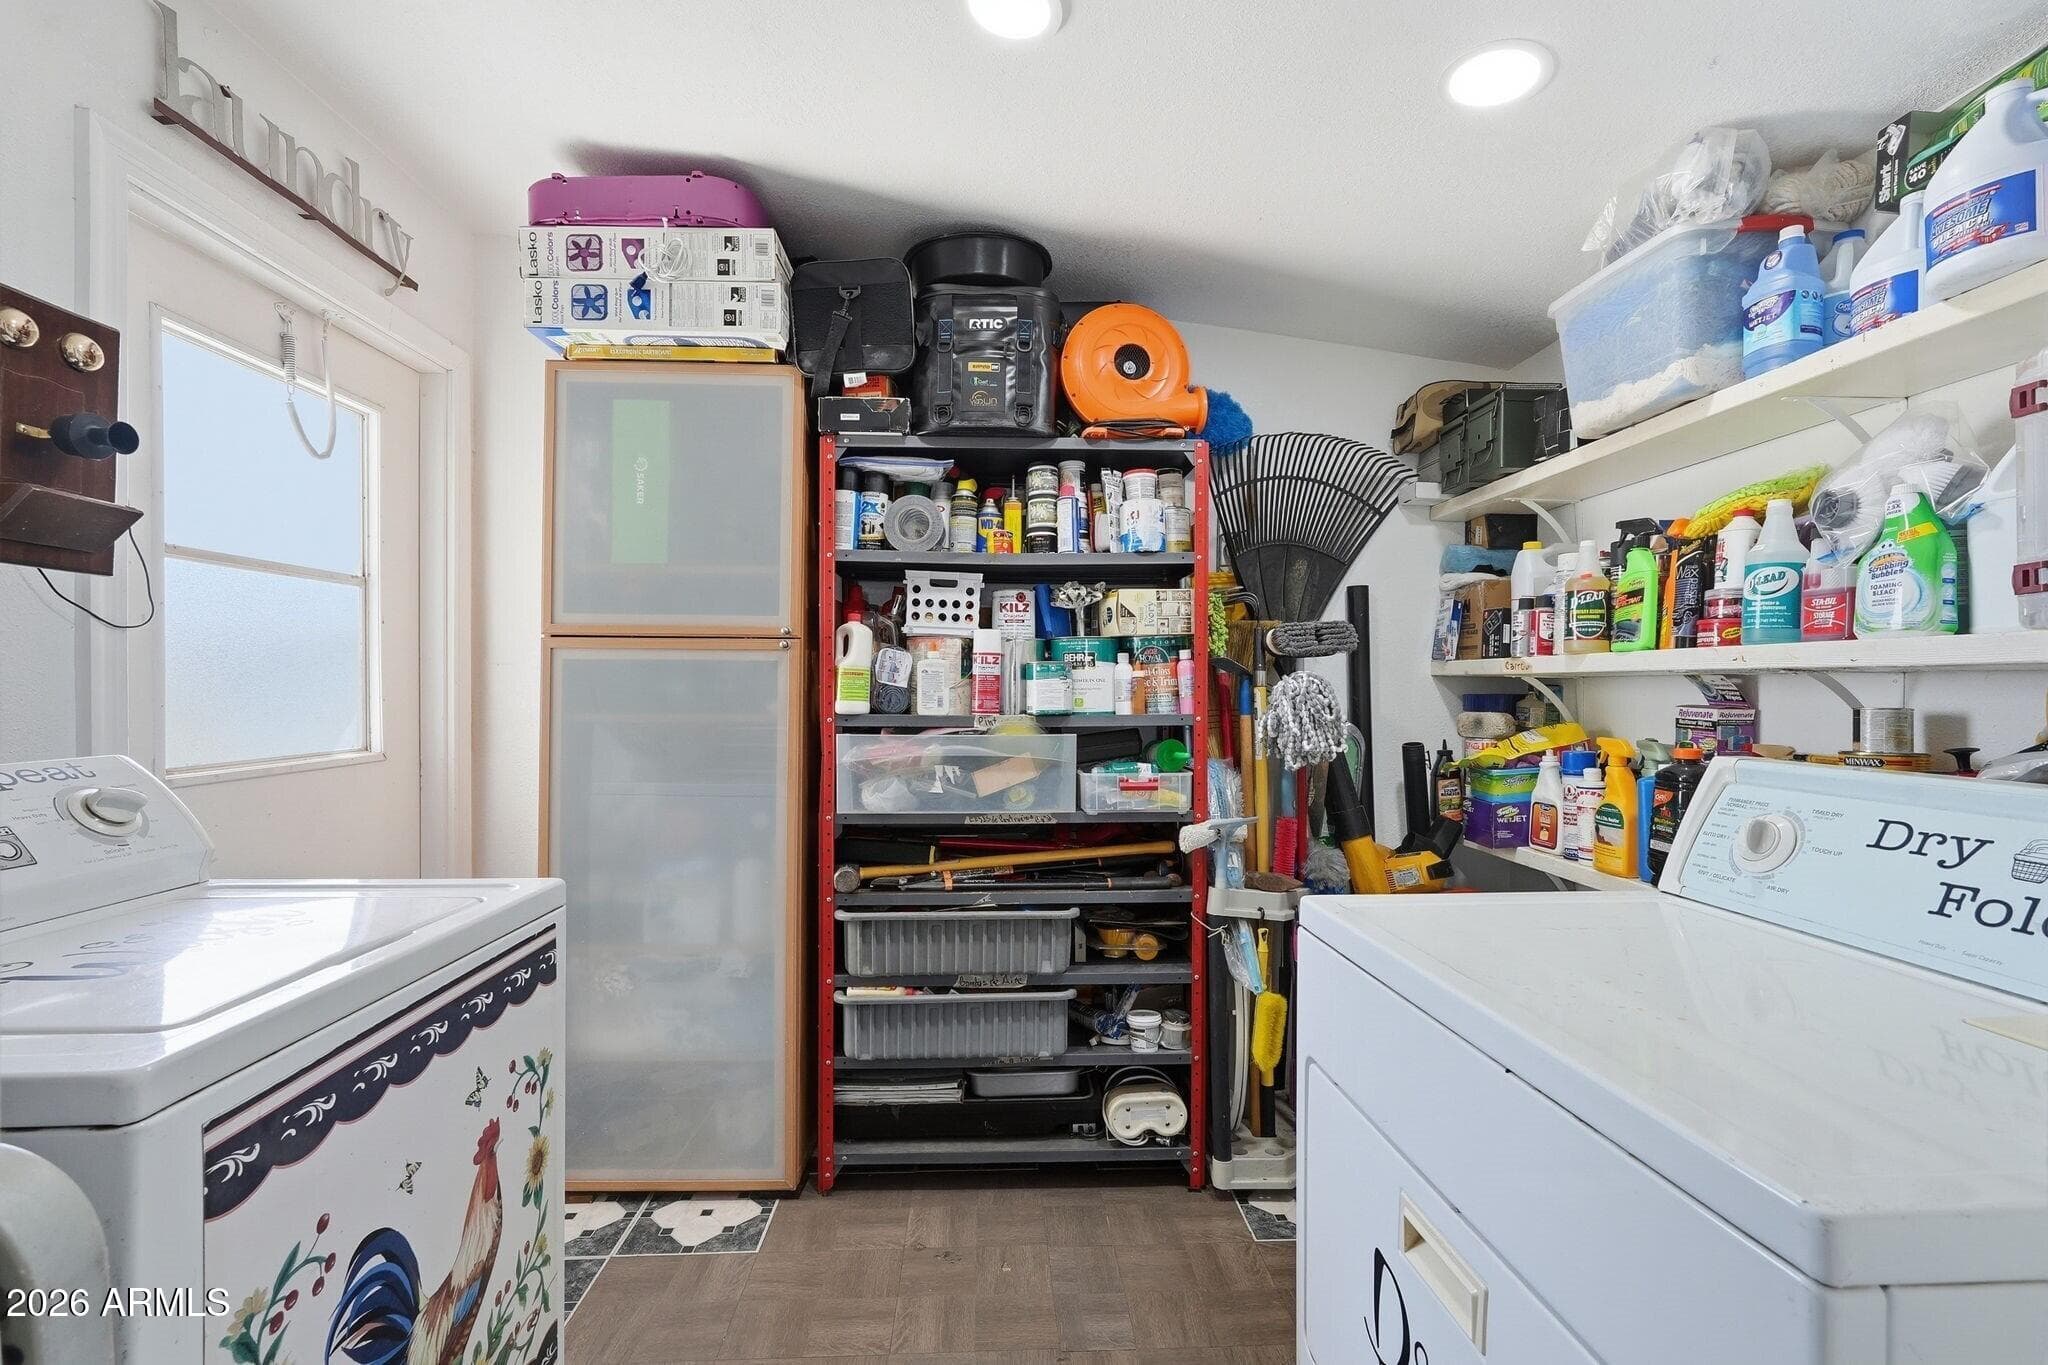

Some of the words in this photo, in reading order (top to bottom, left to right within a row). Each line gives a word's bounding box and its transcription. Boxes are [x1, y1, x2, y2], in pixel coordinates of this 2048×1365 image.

[1878, 160, 1892, 204] Shark
[546, 232, 554, 262] Colors
[527, 231, 539, 277] Lasko
[551, 281, 560, 309] Colors
[532, 280, 543, 324] Lasko
[968, 318, 1004, 330] RTIC
[636, 473, 645, 504] SAKER
[862, 501, 879, 513] 2X
[980, 518, 1004, 530] WD-4
[1677, 564, 1699, 580] Wax
[1868, 560, 1909, 575] Scrubbing
[1871, 568, 1904, 580] Bubbles
[1870, 581, 1902, 590] FOAMING
[1000, 602, 1030, 613] KILZ
[1811, 597, 1837, 606] STA-BIL
[973, 656, 1000, 665] KILZ
[1063, 653, 1085, 662] BEHR
[1678, 708, 1714, 719] Rejuvenate
[1719, 710, 1754, 719] Rejuvenate
[1844, 757, 1882, 767] MINWAX
[0, 763, 97, 792] peat
[1496, 814, 1528, 823] WETJET
[1866, 818, 1995, 869] Dry
[1811, 846, 1833, 855] TOUCH
[1833, 849, 1843, 857] UP
[1713, 872, 1736, 882] DELICATE
[1777, 886, 1790, 895] DRY
[1927, 881, 2048, 938] Fol
